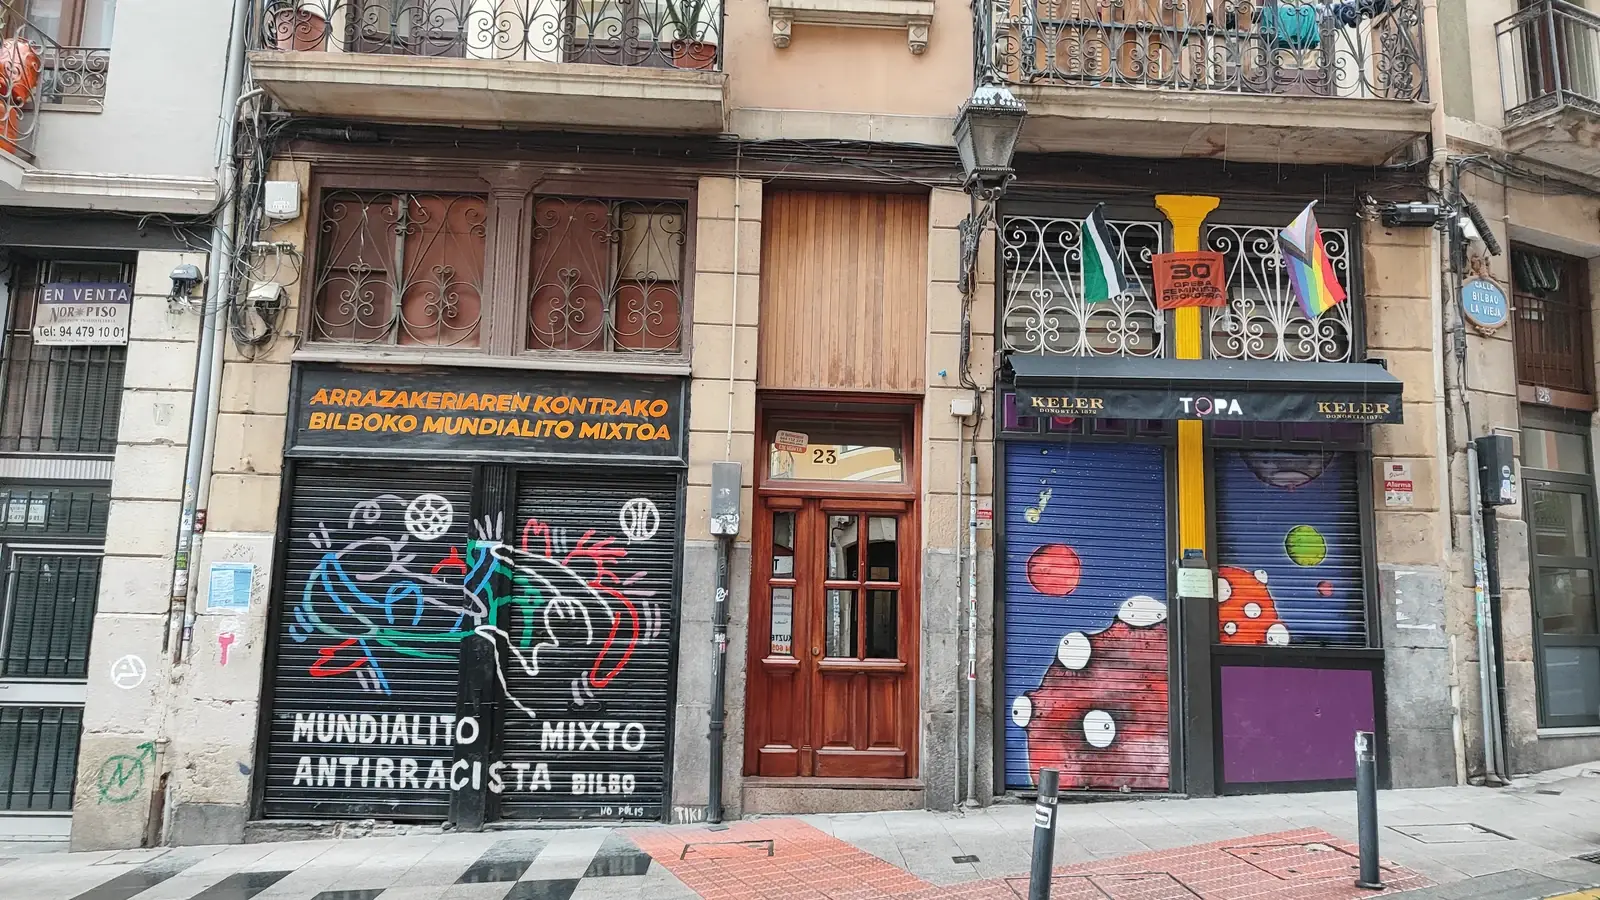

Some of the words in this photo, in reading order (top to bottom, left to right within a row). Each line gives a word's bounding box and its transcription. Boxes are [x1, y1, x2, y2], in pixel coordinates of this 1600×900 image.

[1170, 264, 1211, 279] 30
[1163, 286, 1222, 295] FEMINISTA
[1174, 280, 1212, 288] GREBA
[1474, 281, 1494, 290] CALLE
[44, 288, 64, 301] EN
[73, 288, 128, 301] VENTA
[1163, 293, 1222, 302] OROKORRA
[1472, 291, 1499, 305] BILBAO
[86, 306, 117, 318] PISO
[1470, 303, 1480, 314] LA
[1482, 305, 1502, 318] VIEJA
[38, 325, 56, 337] Tel:
[59, 326, 72, 337] 94
[75, 326, 95, 337] 479
[98, 327, 110, 338] 10
[113, 327, 125, 338] 01
[309, 388, 530, 412] ARRAZAKERIAREN
[533, 395, 669, 418] KONTRAKO
[1030, 396, 1104, 410] KELER
[1179, 397, 1243, 417] TOPA
[1317, 401, 1391, 415] KELER
[308, 412, 418, 432] BILBOKO
[422, 416, 574, 439] MUNDIALITO
[578, 422, 671, 440] MIXTOA
[813, 449, 837, 465] 23
[292, 712, 480, 746] MUNDIALITO
[540, 721, 646, 751] MIXTO
[292, 756, 552, 793] ANTIRRACISTA
[571, 773, 636, 795] BILBO
